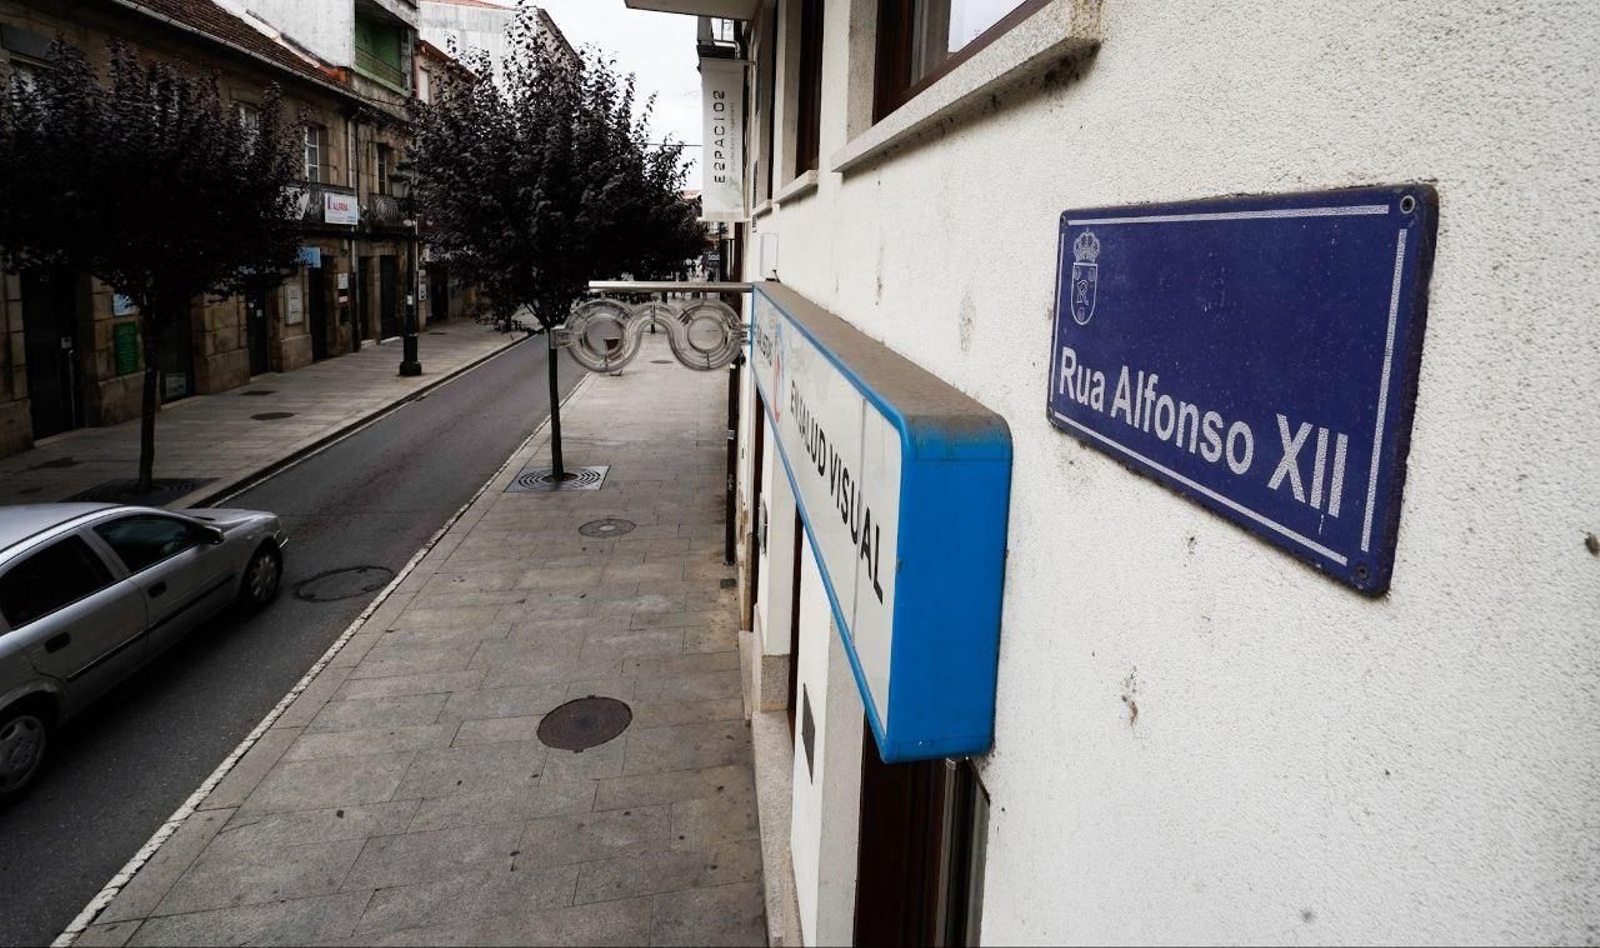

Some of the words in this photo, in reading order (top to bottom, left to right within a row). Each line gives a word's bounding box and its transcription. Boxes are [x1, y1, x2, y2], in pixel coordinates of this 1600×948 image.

[800, 398, 826, 477] SALUD
[829, 443, 883, 605] VISUAL
[1059, 346, 1106, 413] Rua
[1110, 365, 1255, 475] Alfonso
[1267, 413, 1348, 518] XII
